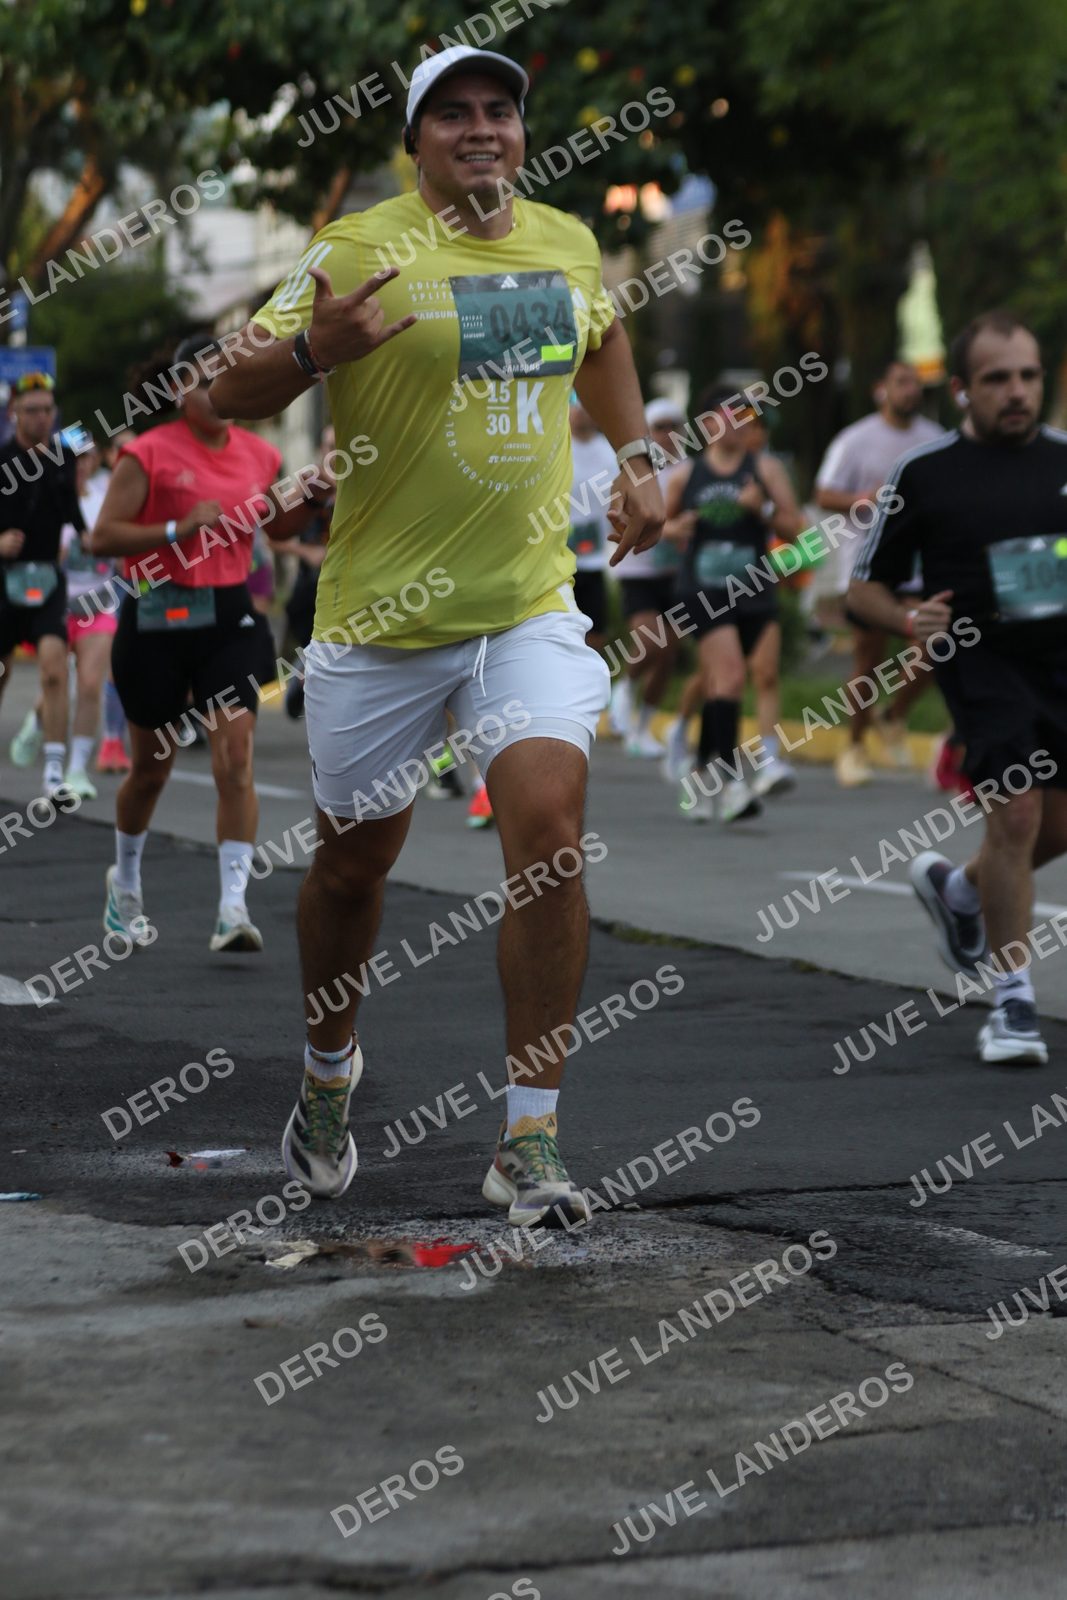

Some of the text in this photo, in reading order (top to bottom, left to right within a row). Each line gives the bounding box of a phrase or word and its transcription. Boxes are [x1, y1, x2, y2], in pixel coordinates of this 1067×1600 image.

[408, 279, 452, 291] ADIDA
[489, 299, 573, 343] 0434
[502, 363, 541, 373] SAMSUNG
[487, 380, 511, 404] 15
[516, 381, 545, 436] K
[485, 413, 511, 437] 30
